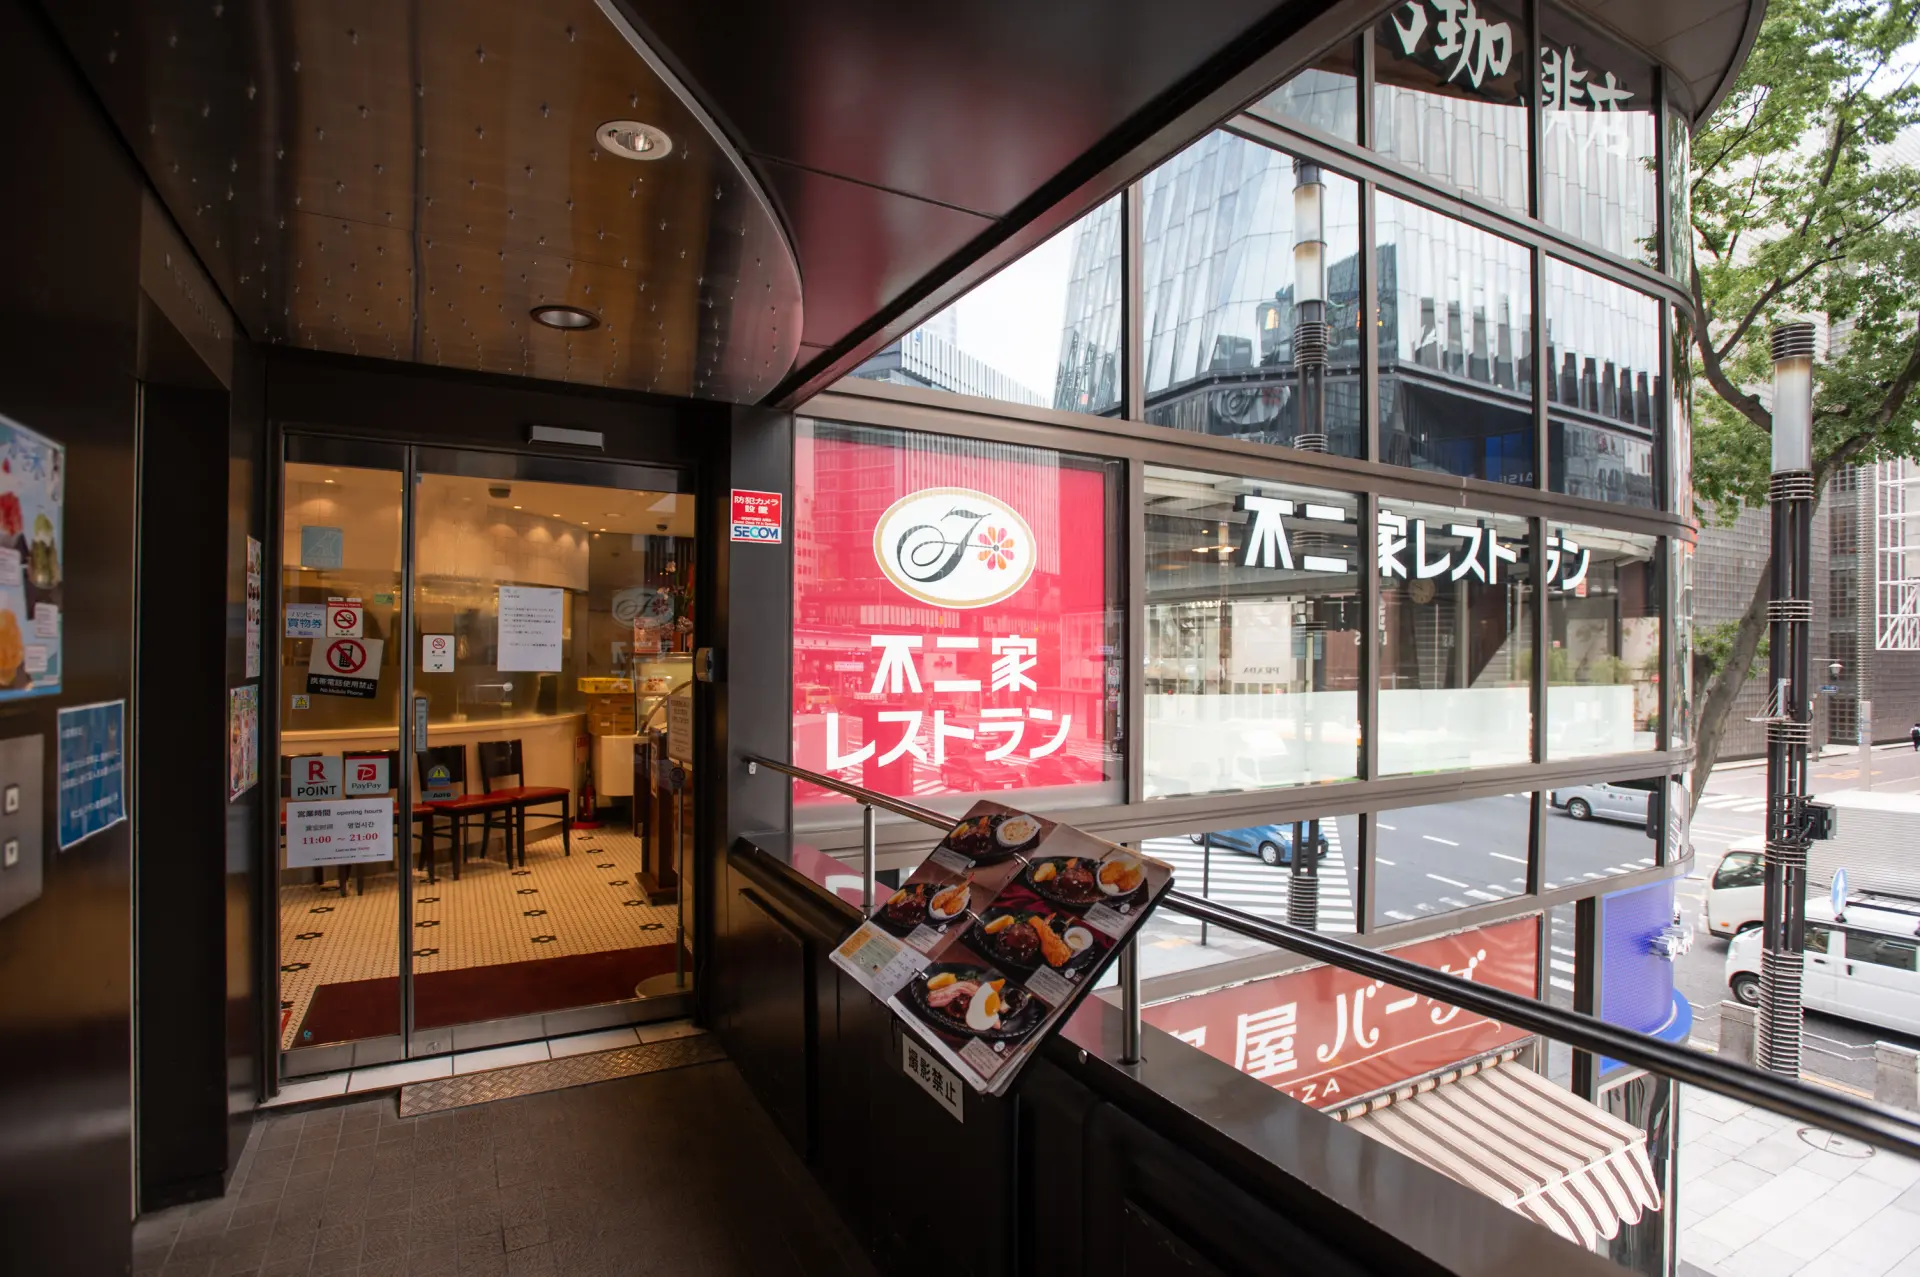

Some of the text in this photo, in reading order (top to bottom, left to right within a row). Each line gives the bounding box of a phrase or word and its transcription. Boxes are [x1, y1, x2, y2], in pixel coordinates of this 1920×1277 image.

[1390, 0, 1635, 159] 珈琲店
[734, 496, 779, 506] 防犯カメラ
[734, 526, 779, 539] SECOM
[287, 618, 322, 629] 買物券
[870, 634, 1037, 694] 不二家
[310, 677, 374, 690] 携帯電話使用禁止
[826, 707, 1072, 771] レストラン
[308, 760, 327, 781] R
[297, 785, 337, 797] POINT
[352, 782, 382, 790] PayPay
[302, 835, 331, 845] 11:00
[349, 832, 379, 842] 21:00
[1168, 949, 1487, 1079] 屋バーグ
